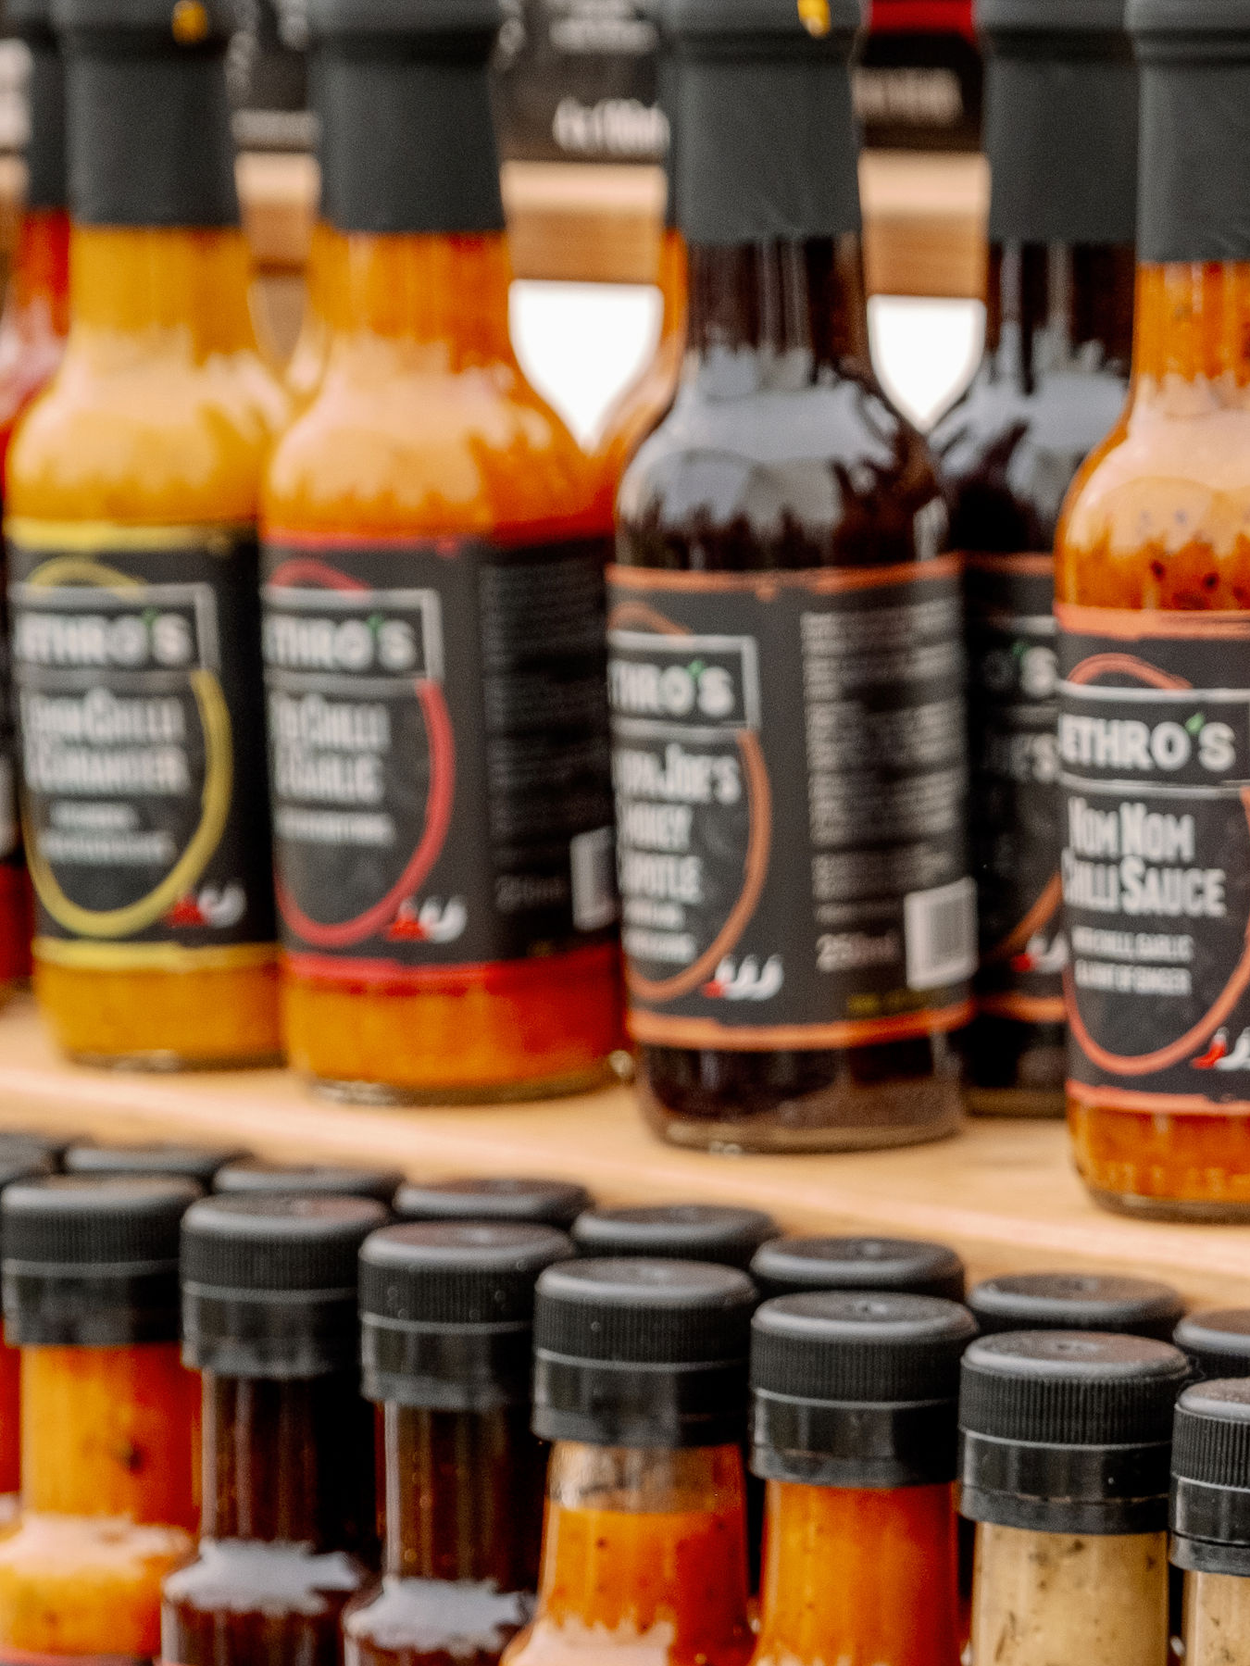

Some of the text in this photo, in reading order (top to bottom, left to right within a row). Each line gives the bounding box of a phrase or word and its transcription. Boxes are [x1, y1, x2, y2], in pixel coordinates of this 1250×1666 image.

[1058, 711, 1236, 773] ETHRO'S
[1119, 802, 1196, 863] NOM
[1120, 855, 1227, 917] SAUCE
